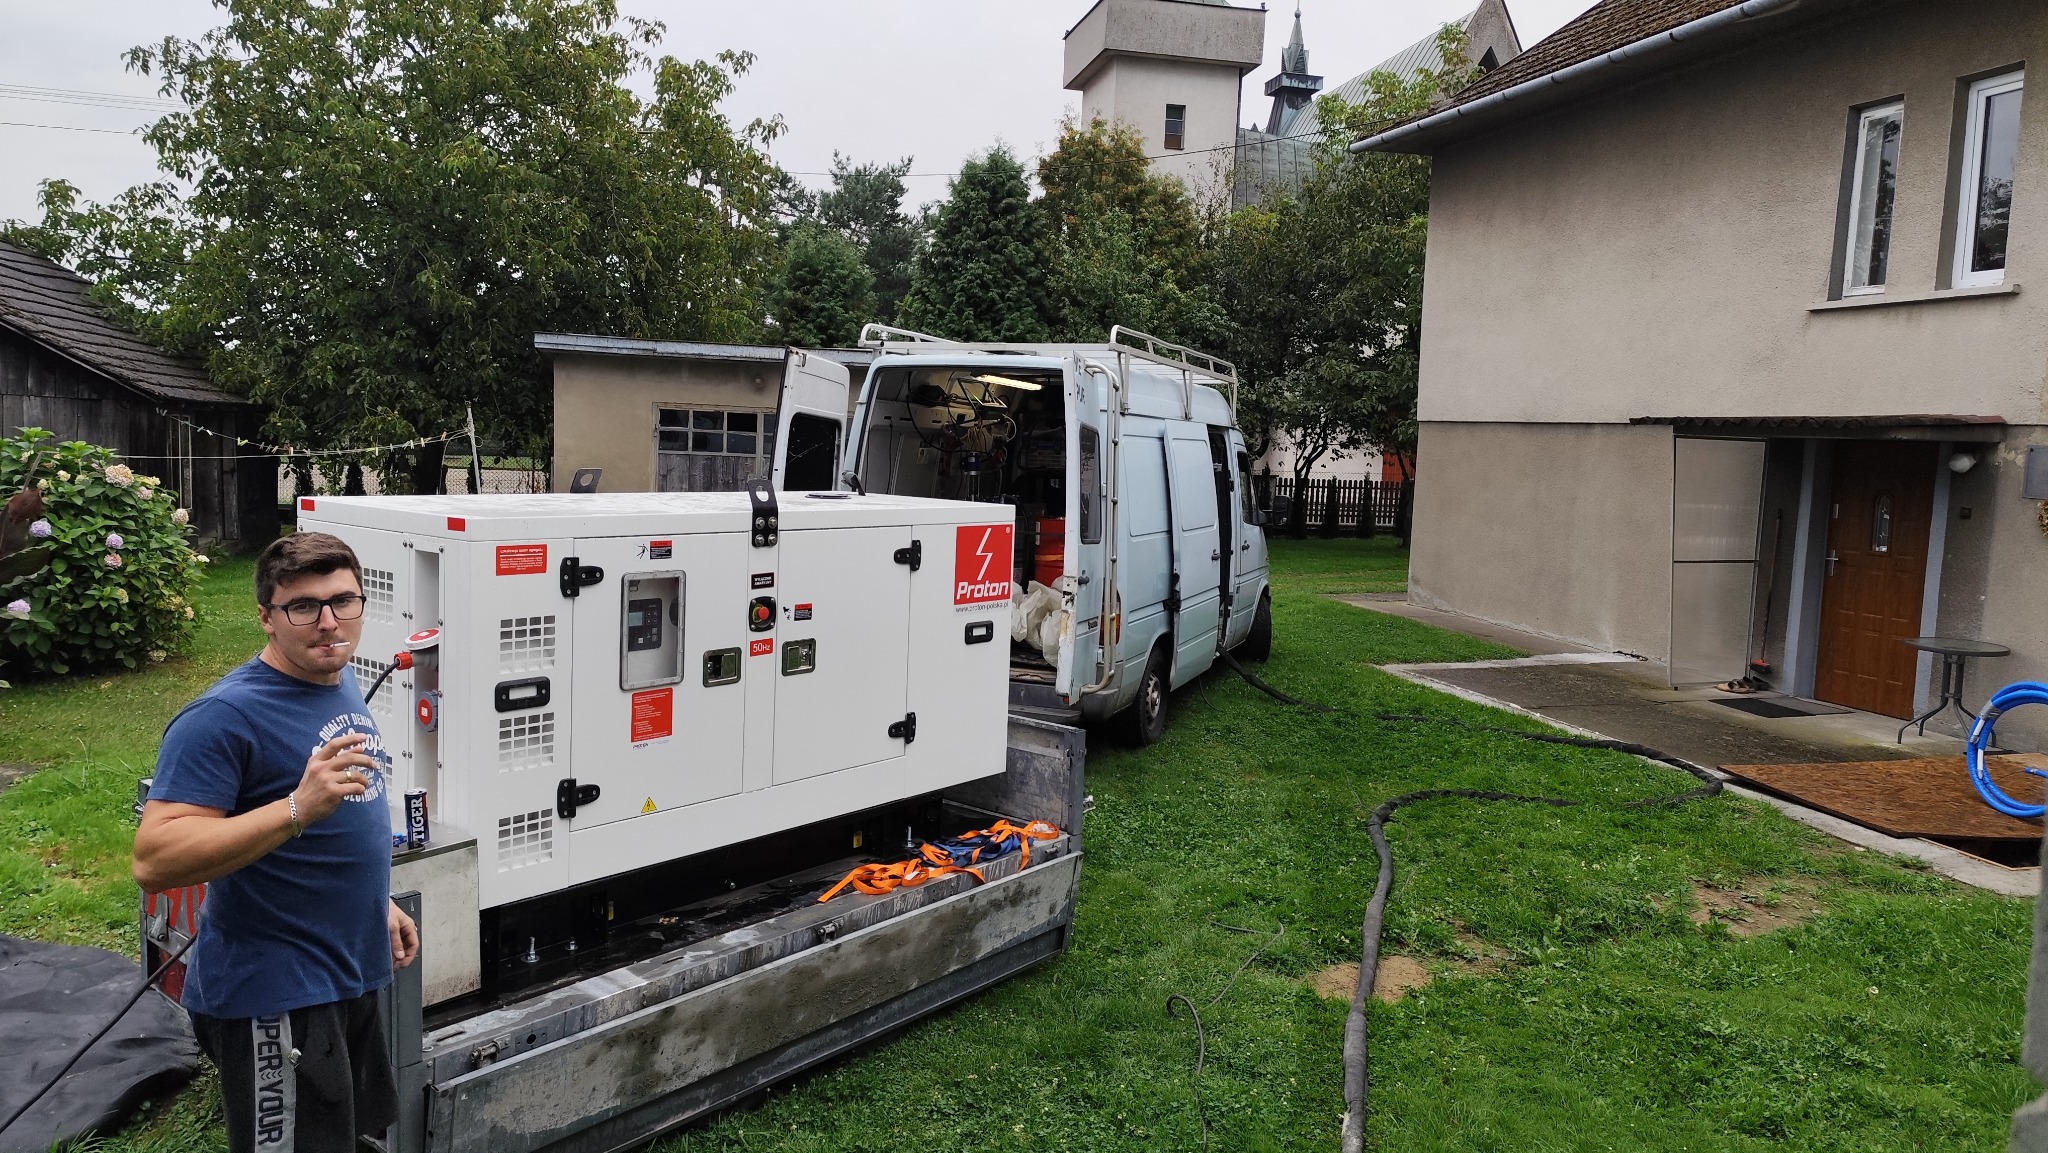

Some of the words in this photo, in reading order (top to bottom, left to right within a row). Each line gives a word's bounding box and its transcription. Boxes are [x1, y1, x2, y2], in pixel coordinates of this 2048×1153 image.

[956, 580, 1009, 600] Proton
[753, 642, 770, 653] 50Hz
[319, 713, 350, 742] QUALITY
[411, 797, 424, 842] TIGER
[258, 1079, 284, 1146] YOUR
